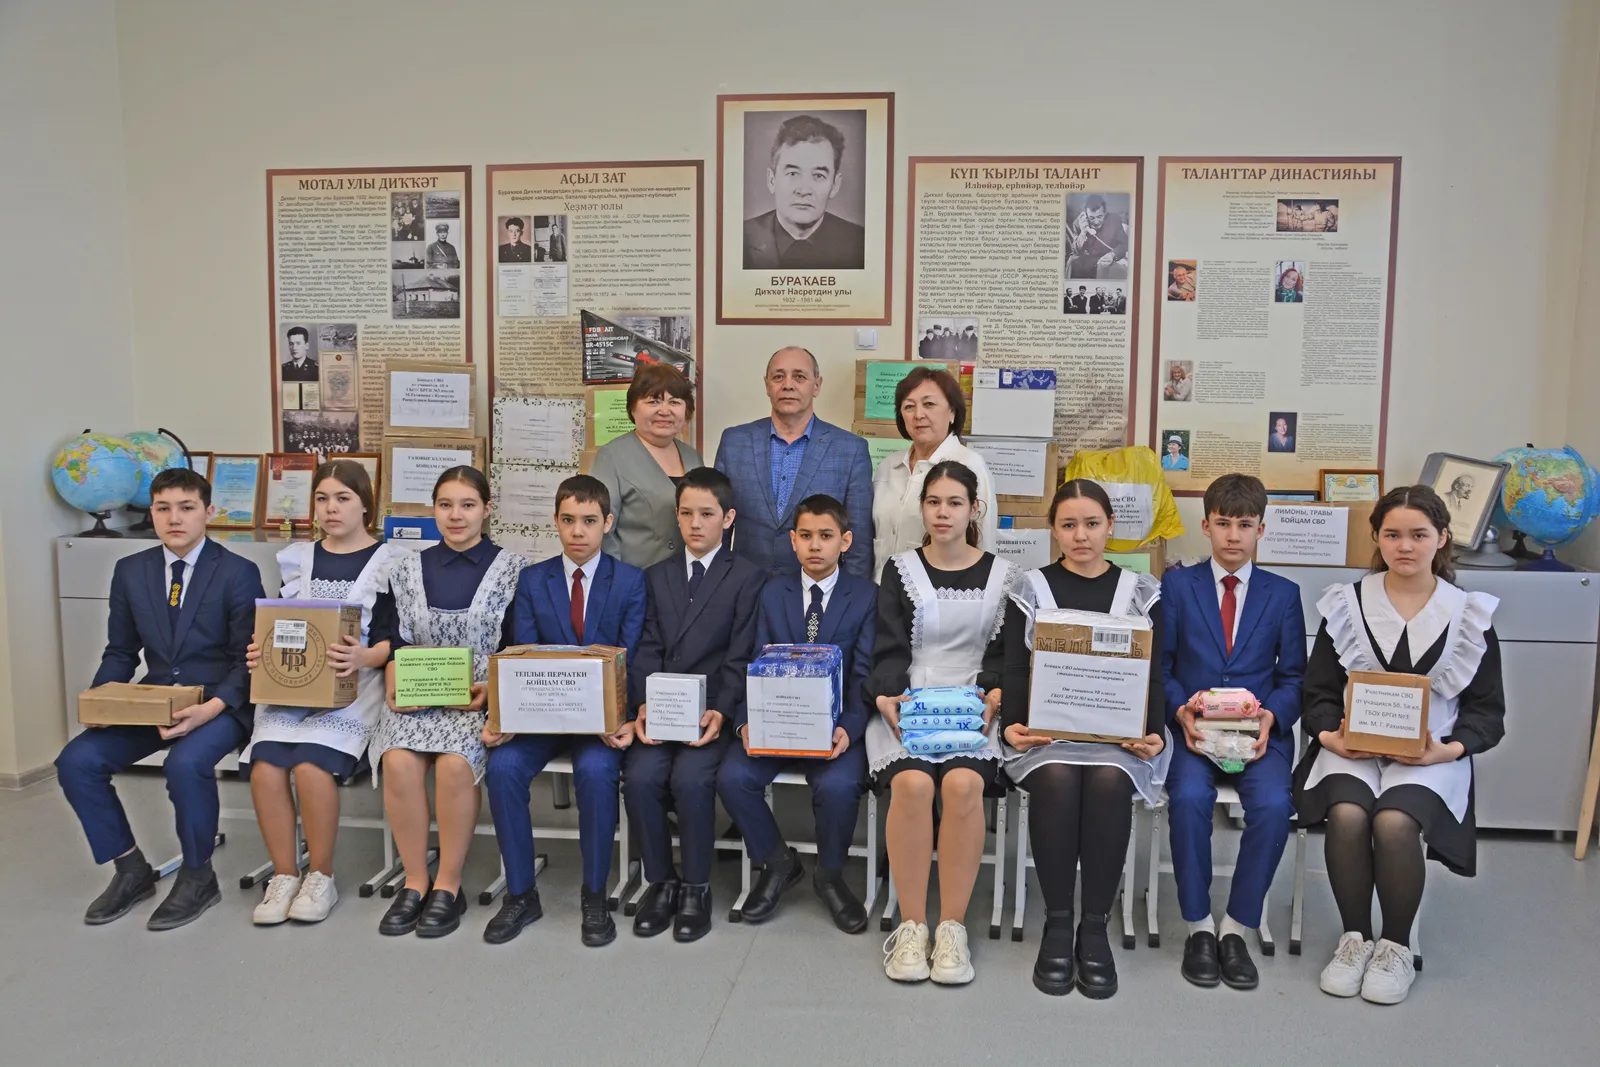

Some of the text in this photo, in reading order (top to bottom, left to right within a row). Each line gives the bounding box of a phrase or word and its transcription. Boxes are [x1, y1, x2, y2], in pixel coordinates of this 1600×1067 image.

[950, 168, 1100, 179] КҮП ҠЫРЛЫ ТАЛАНТ
[1182, 168, 1376, 181] ТАЛАНТТАР ДИНАСТИЯҺЫ
[299, 177, 438, 191] МОТАЛ УЛЫ ДИҠҠӘТ
[560, 172, 626, 186] АҪЫЛ ЗАТ
[564, 202, 598, 212] Хеҙмәт
[771, 276, 836, 286] БУРАҠАЕВ
[755, 288, 785, 296] Диҡҡәт
[788, 288, 832, 296] Насретдин
[1274, 508, 1308, 516] ЛИМОНЫ,
[1036, 638, 1143, 658] МЕДЬ
[1365, 688, 1400, 697] Участникам
[913, 702, 927, 710] XL
[1386, 723, 1415, 731] Рахимова
